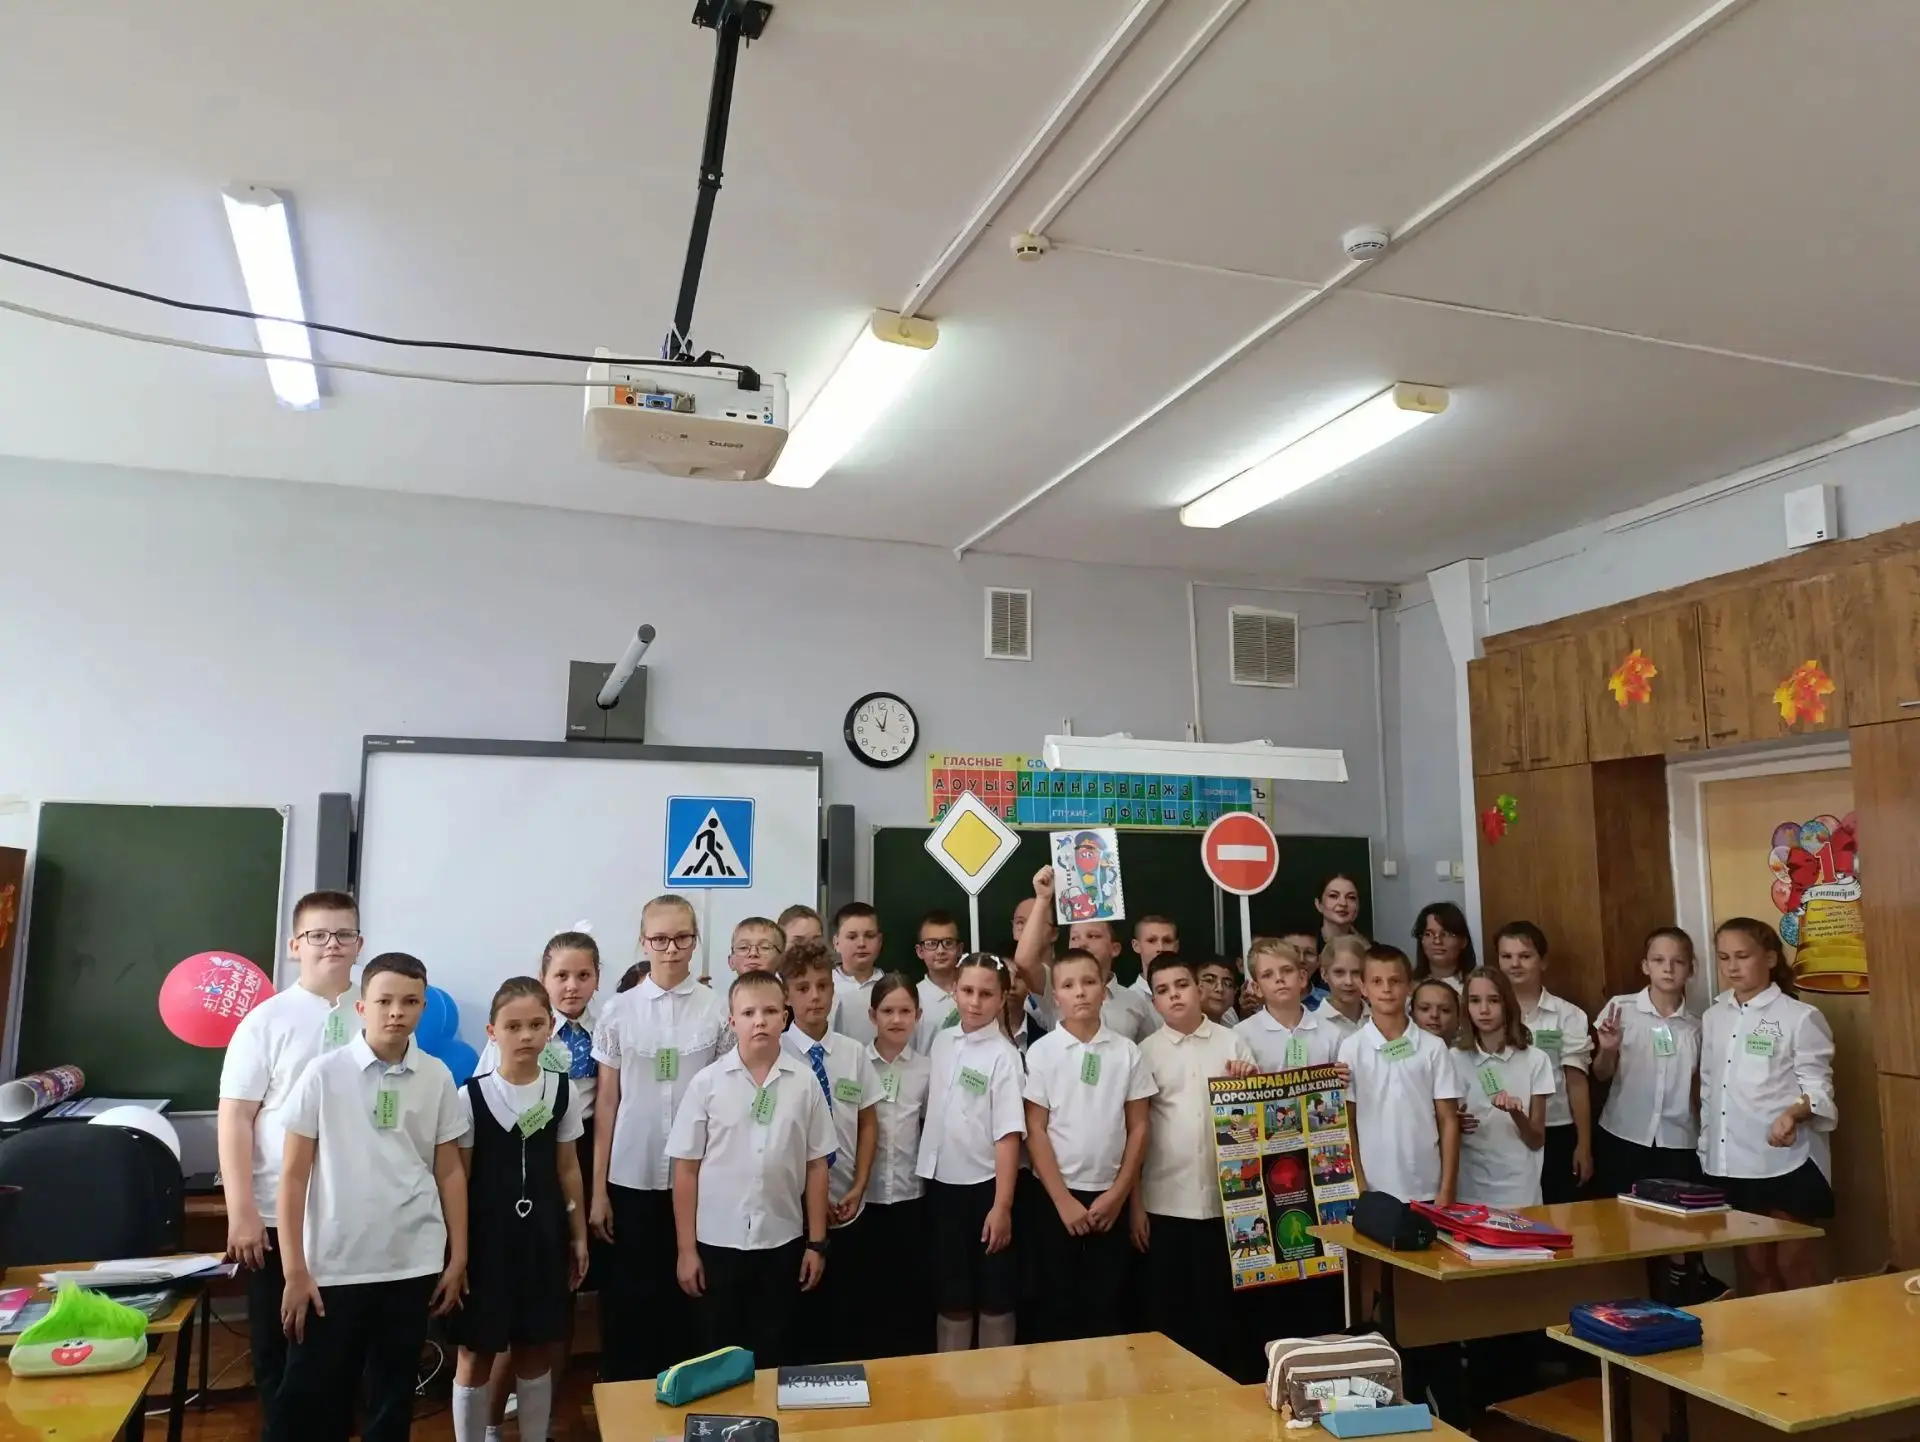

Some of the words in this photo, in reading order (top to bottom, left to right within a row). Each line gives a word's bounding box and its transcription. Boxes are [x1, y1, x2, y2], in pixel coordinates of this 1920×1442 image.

[867, 705, 874, 713] 11
[877, 702, 887, 711] 12
[891, 705, 895, 713] 1
[859, 714, 868, 722] 10
[898, 713, 906, 722] 2
[857, 726, 864, 735] 9
[902, 725, 909, 734] 3
[861, 737, 868, 746] 8
[900, 736, 906, 744] 4
[870, 746, 876, 754] 7
[880, 749, 888, 757] 6
[891, 746, 899, 754] 5
[943, 756, 1003, 768] ГЛАСНЫЕ
[935, 778, 944, 790] А
[952, 778, 962, 790] О
[967, 778, 977, 791] У
[985, 780, 998, 791] Ы
[1005, 780, 1015, 792] Э
[1021, 776, 1031, 791] Й
[1037, 781, 1046, 792] Л
[1053, 781, 1065, 792] М
[1071, 781, 1080, 792] Н
[1087, 781, 1096, 792] Р
[1103, 783, 1113, 793] Б
[1119, 784, 1127, 794] В
[1134, 784, 1141, 794] Г
[1148, 784, 1157, 796] Д
[1163, 784, 1175, 795] Ж
[1182, 785, 1189, 795] З
[1252, 788, 1265, 799] Ъ
[938, 803, 947, 816] Я
[1006, 806, 1015, 817] Е
[1104, 807, 1113, 819] П
[1120, 807, 1131, 818] Ф
[1137, 808, 1144, 819] К
[1150, 808, 1157, 819] Т
[1163, 809, 1176, 820] Ш
[1182, 809, 1191, 820] С
[1815, 841, 1837, 884] 1
[218, 970, 244, 1018] НОВЫМ
[1246, 1070, 1310, 1089] ПРАВИЛА
[1212, 1089, 1284, 1105] ДОРОЖНОГО
[1287, 1078, 1342, 1097] ДВИЖЕНИЯ
